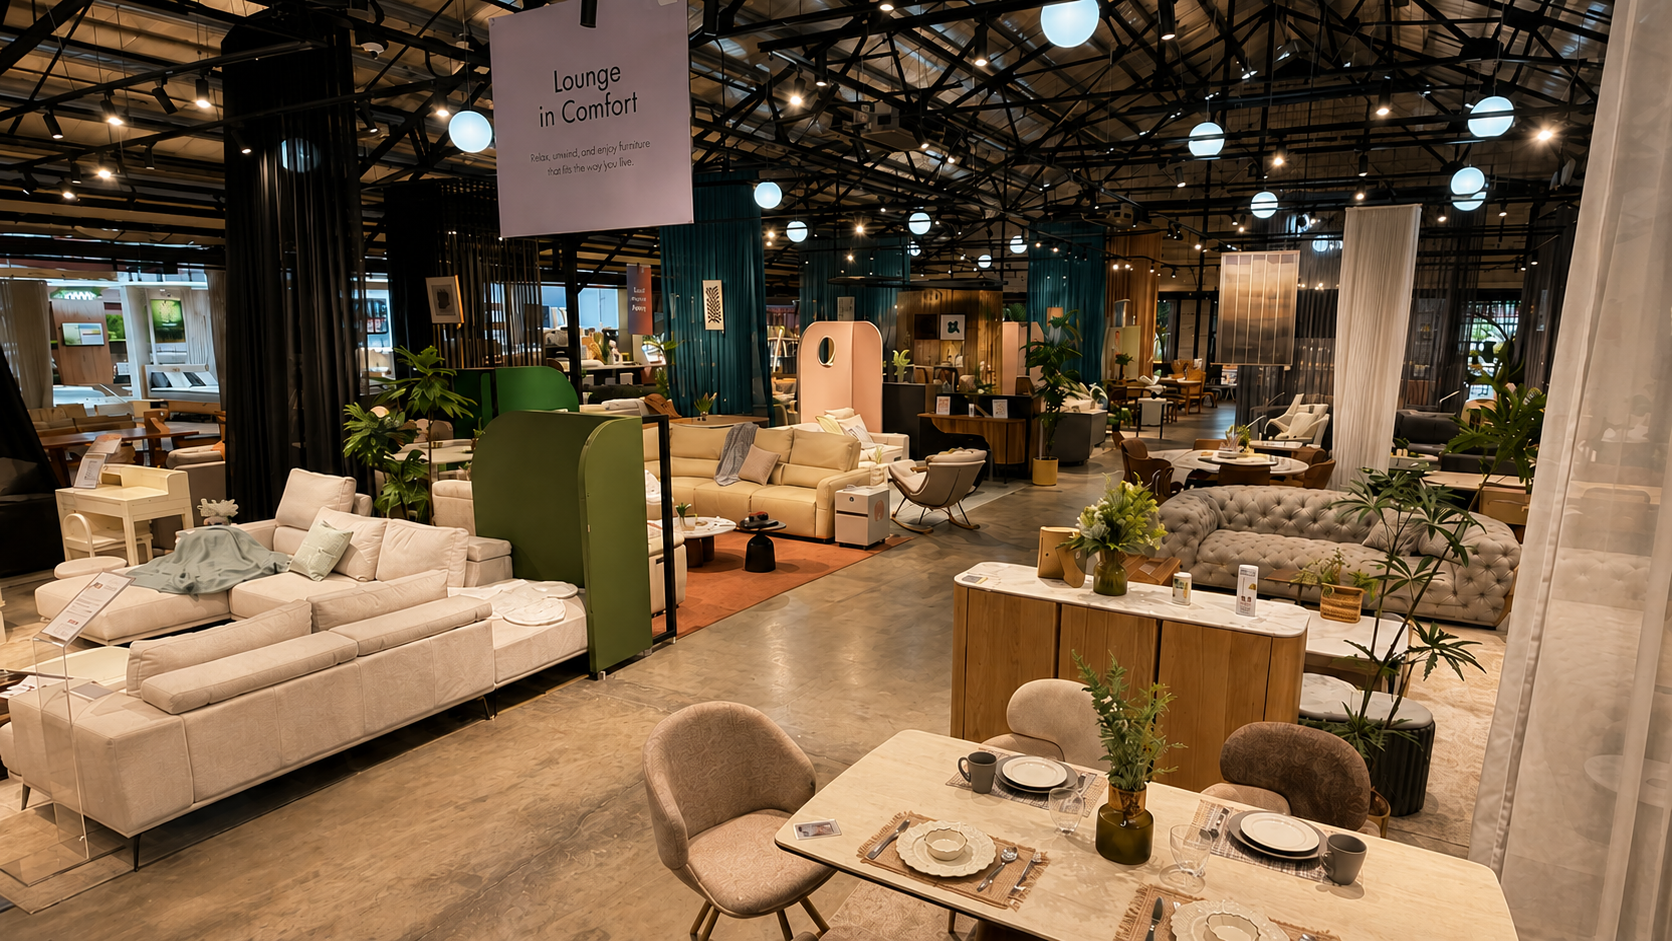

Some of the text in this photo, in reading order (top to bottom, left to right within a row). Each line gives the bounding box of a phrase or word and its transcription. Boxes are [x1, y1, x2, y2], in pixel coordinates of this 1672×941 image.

[554, 66, 621, 93] Lounge
[539, 92, 638, 127] in Comfort
[581, 146, 596, 157] and
[598, 143, 617, 155] enjoy
[618, 140, 651, 151] furniture
[547, 167, 561, 176] that
[574, 163, 586, 173] the
[587, 162, 602, 173] way
[603, 160, 617, 172] you
